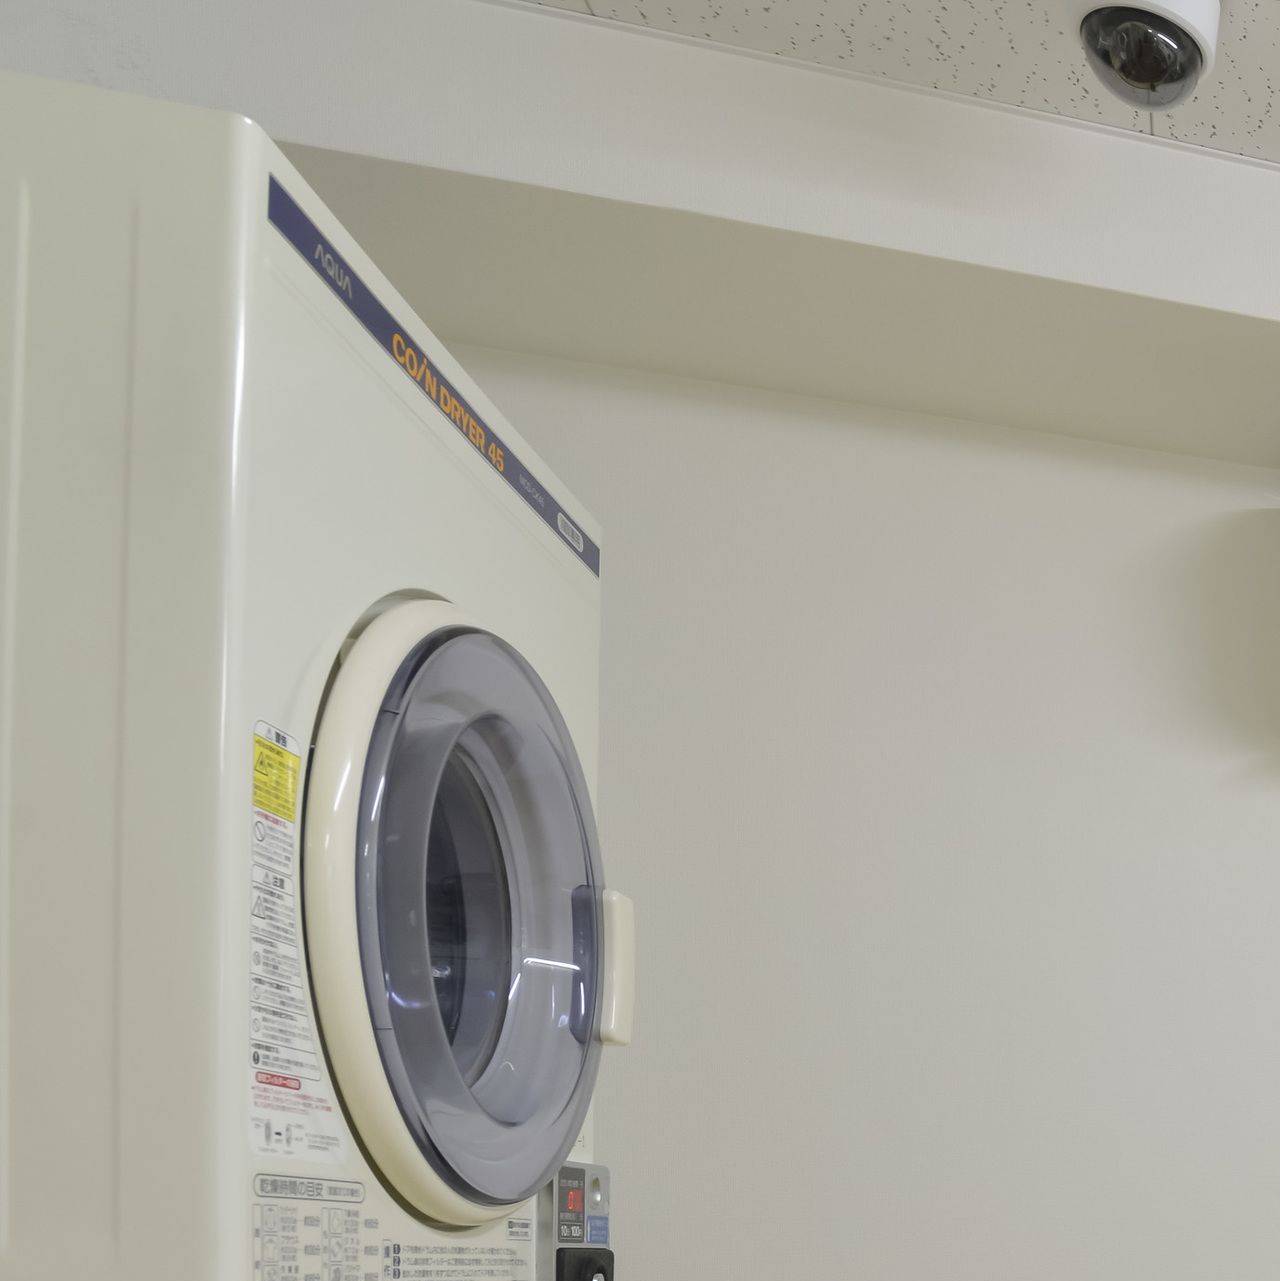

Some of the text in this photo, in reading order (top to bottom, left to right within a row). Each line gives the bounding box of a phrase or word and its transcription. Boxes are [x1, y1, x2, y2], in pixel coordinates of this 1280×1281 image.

[315, 244, 353, 299] AQUA
[393, 333, 505, 473] COIN DRYER 45
